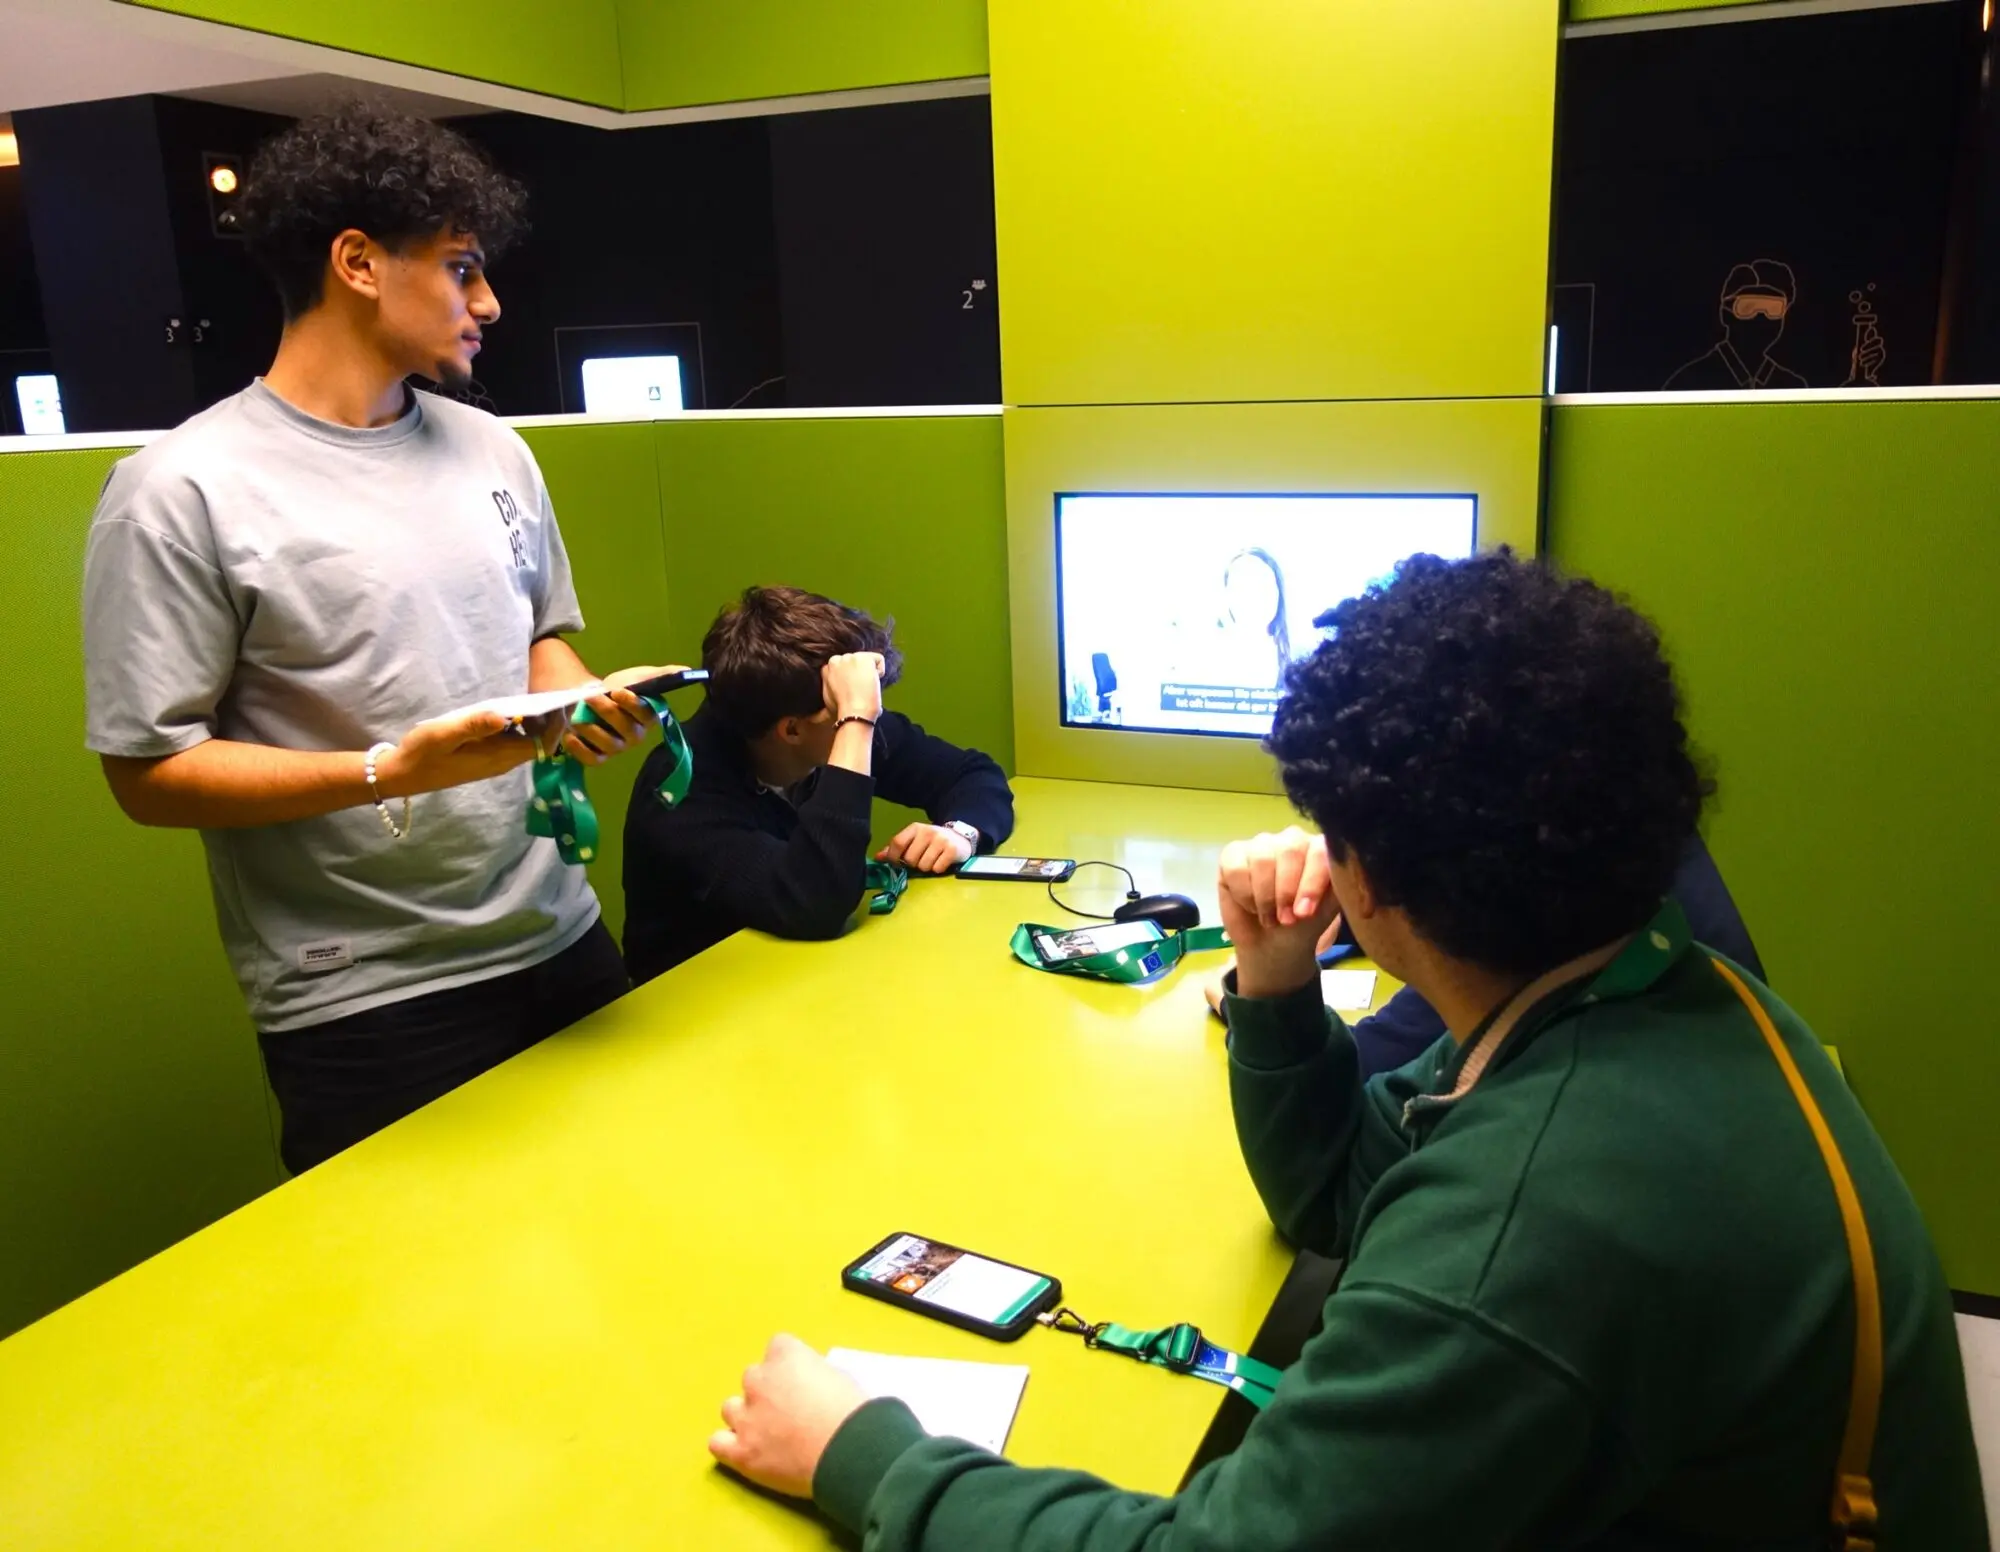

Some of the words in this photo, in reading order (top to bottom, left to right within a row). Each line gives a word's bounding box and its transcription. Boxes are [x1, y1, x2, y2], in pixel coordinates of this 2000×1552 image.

[962, 290, 974, 309] 2
[165, 327, 174, 343] 3
[193, 326, 203, 342] 3
